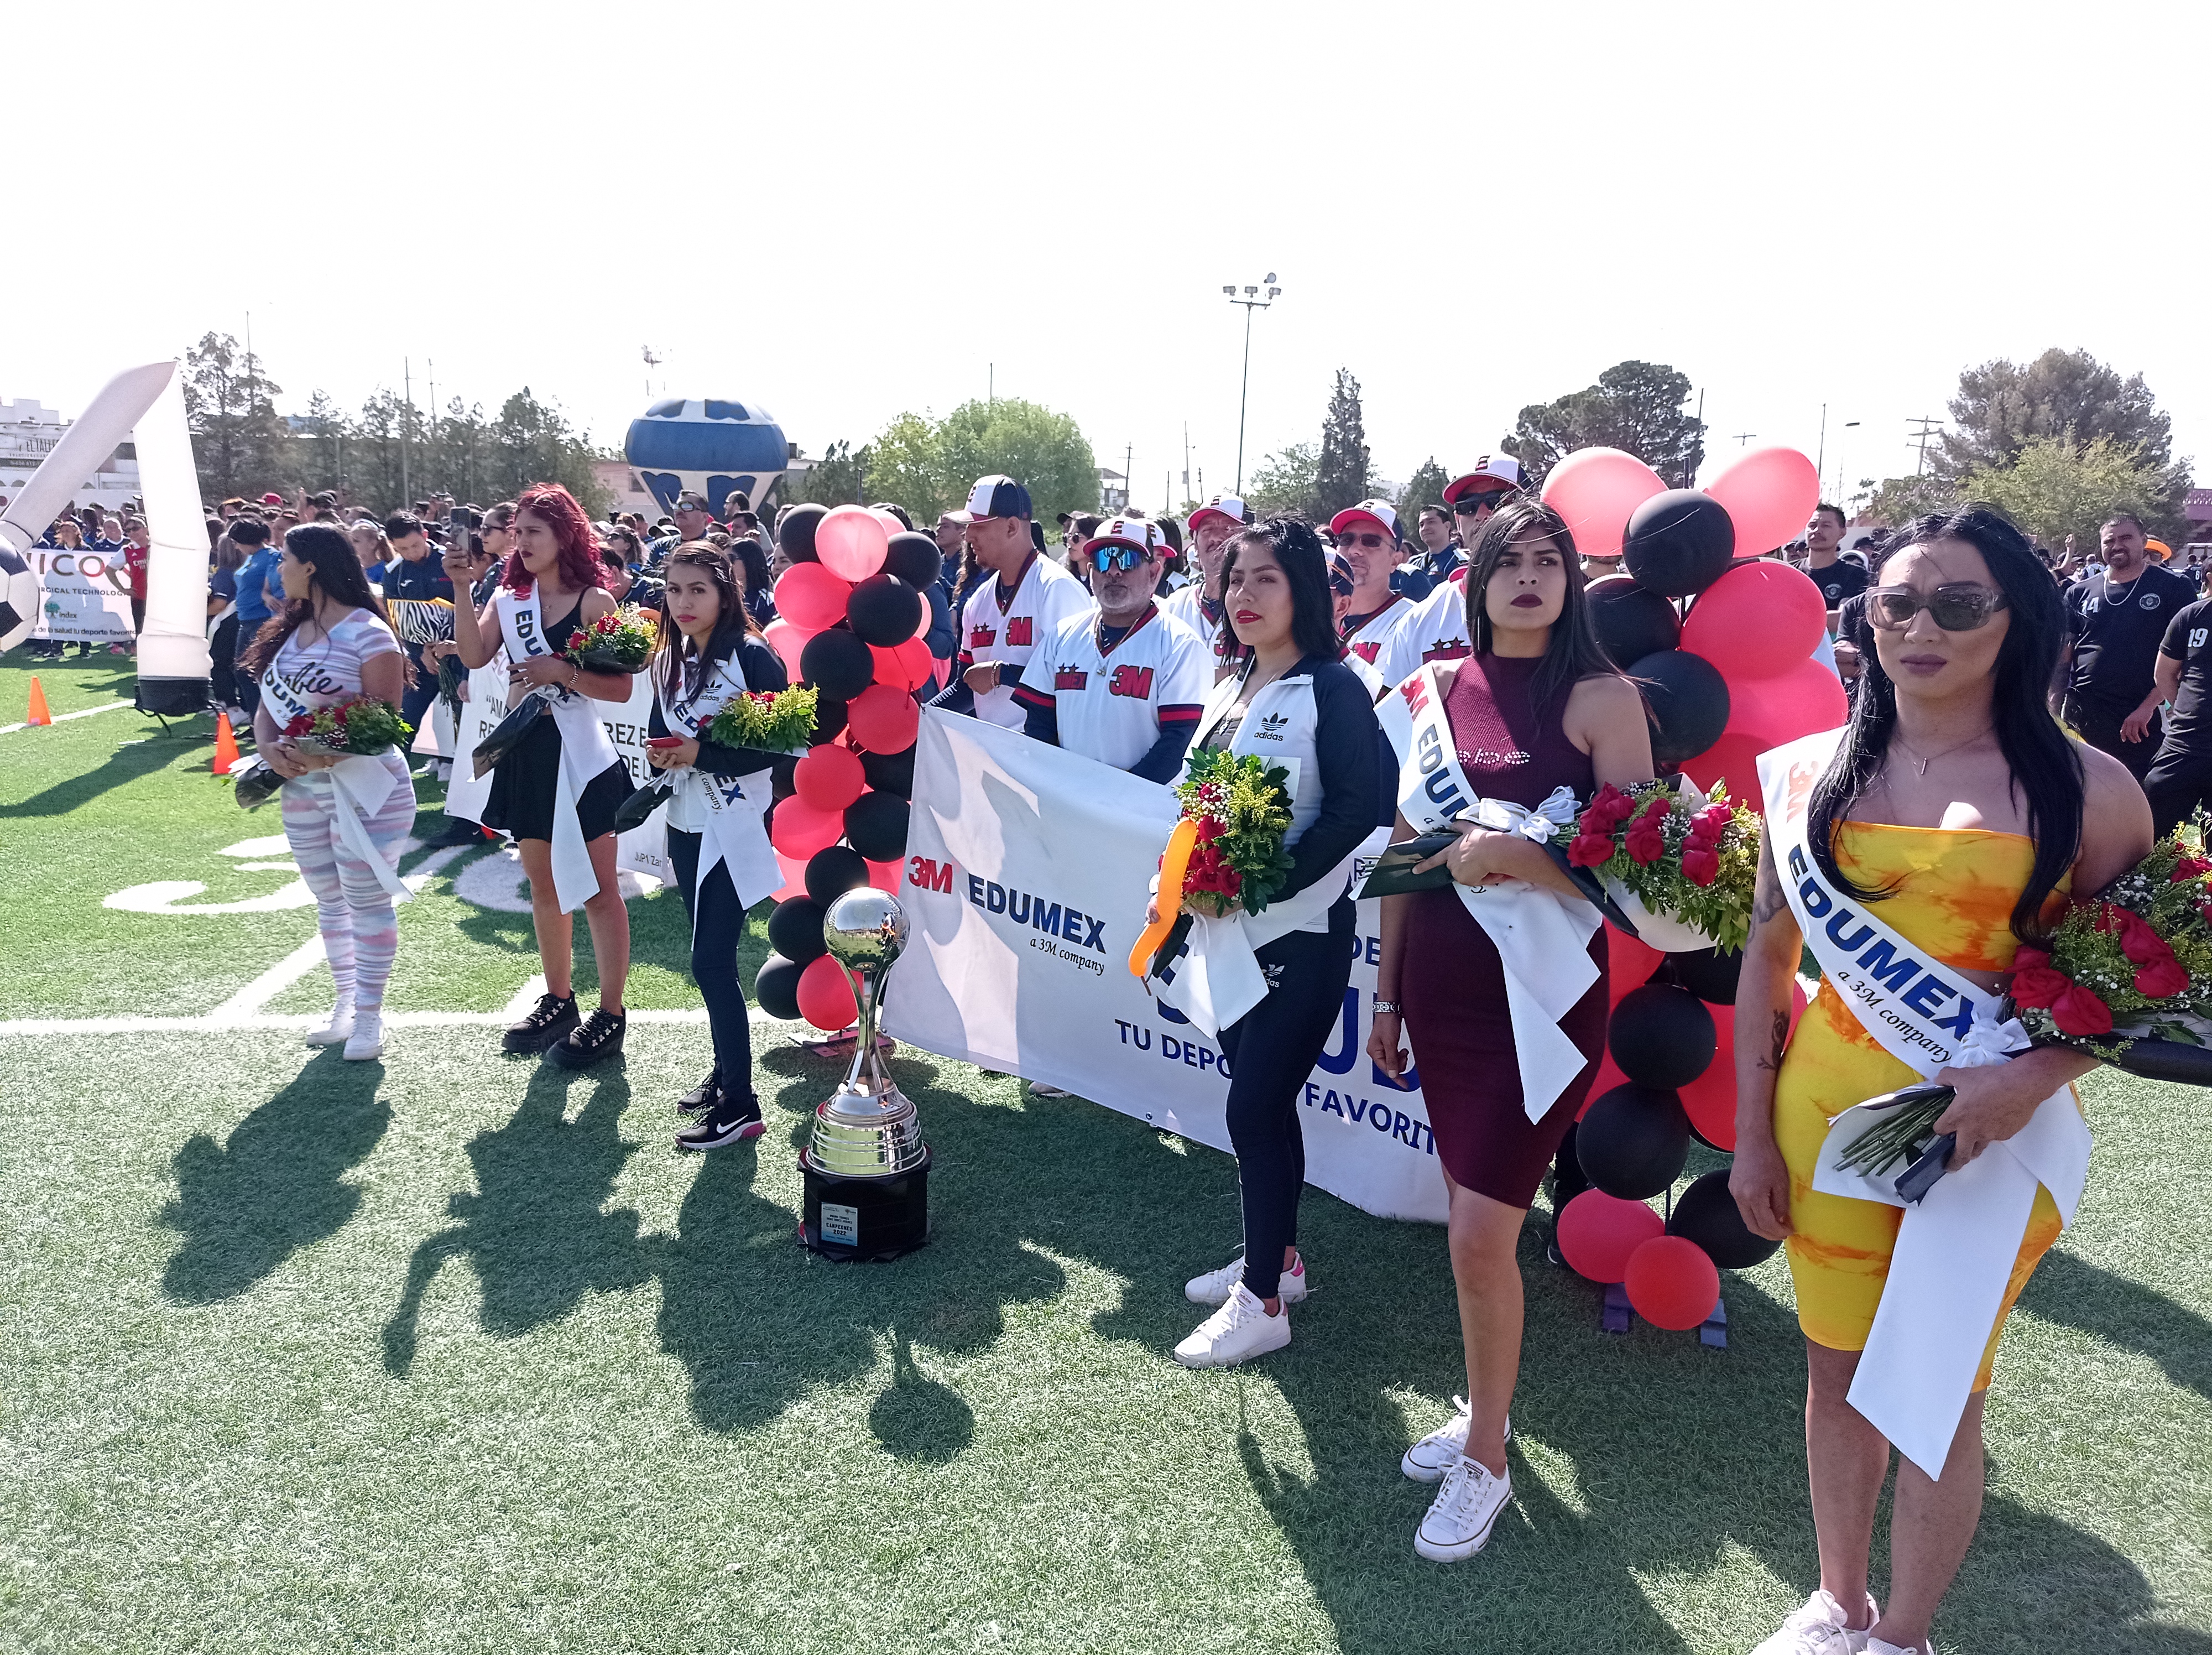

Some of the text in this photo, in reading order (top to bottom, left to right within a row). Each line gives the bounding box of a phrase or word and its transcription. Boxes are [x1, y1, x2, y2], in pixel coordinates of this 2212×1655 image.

[1475, 455, 1491, 471] E
[1211, 495, 1222, 506] E
[1110, 521, 1124, 534] E
[1146, 523, 1157, 539] E
[72, 588, 126, 596] TECHNOLOG
[2081, 597, 2099, 615] 14
[1006, 616, 1032, 647] 3M
[2188, 628, 2208, 648] 19
[1109, 664, 1154, 701] 3M
[1400, 674, 1430, 722] 3M
[603, 722, 635, 746] REZ
[1254, 731, 1284, 741] adidas
[701, 778, 722, 810] company
[1786, 761, 1819, 824] 3M
[908, 855, 953, 894] 3M
[968, 873, 1107, 954] EDUMEX
[1788, 844, 1975, 1042] EDUMEX
[1029, 938, 1105, 976] a 3M company
[1266, 977, 1280, 988] das
[1838, 970, 1952, 1063] a 3M company
[1115, 1018, 1435, 1156] TU DEPO FAVORIT
[826, 1222, 853, 1231] CAMPEONES
